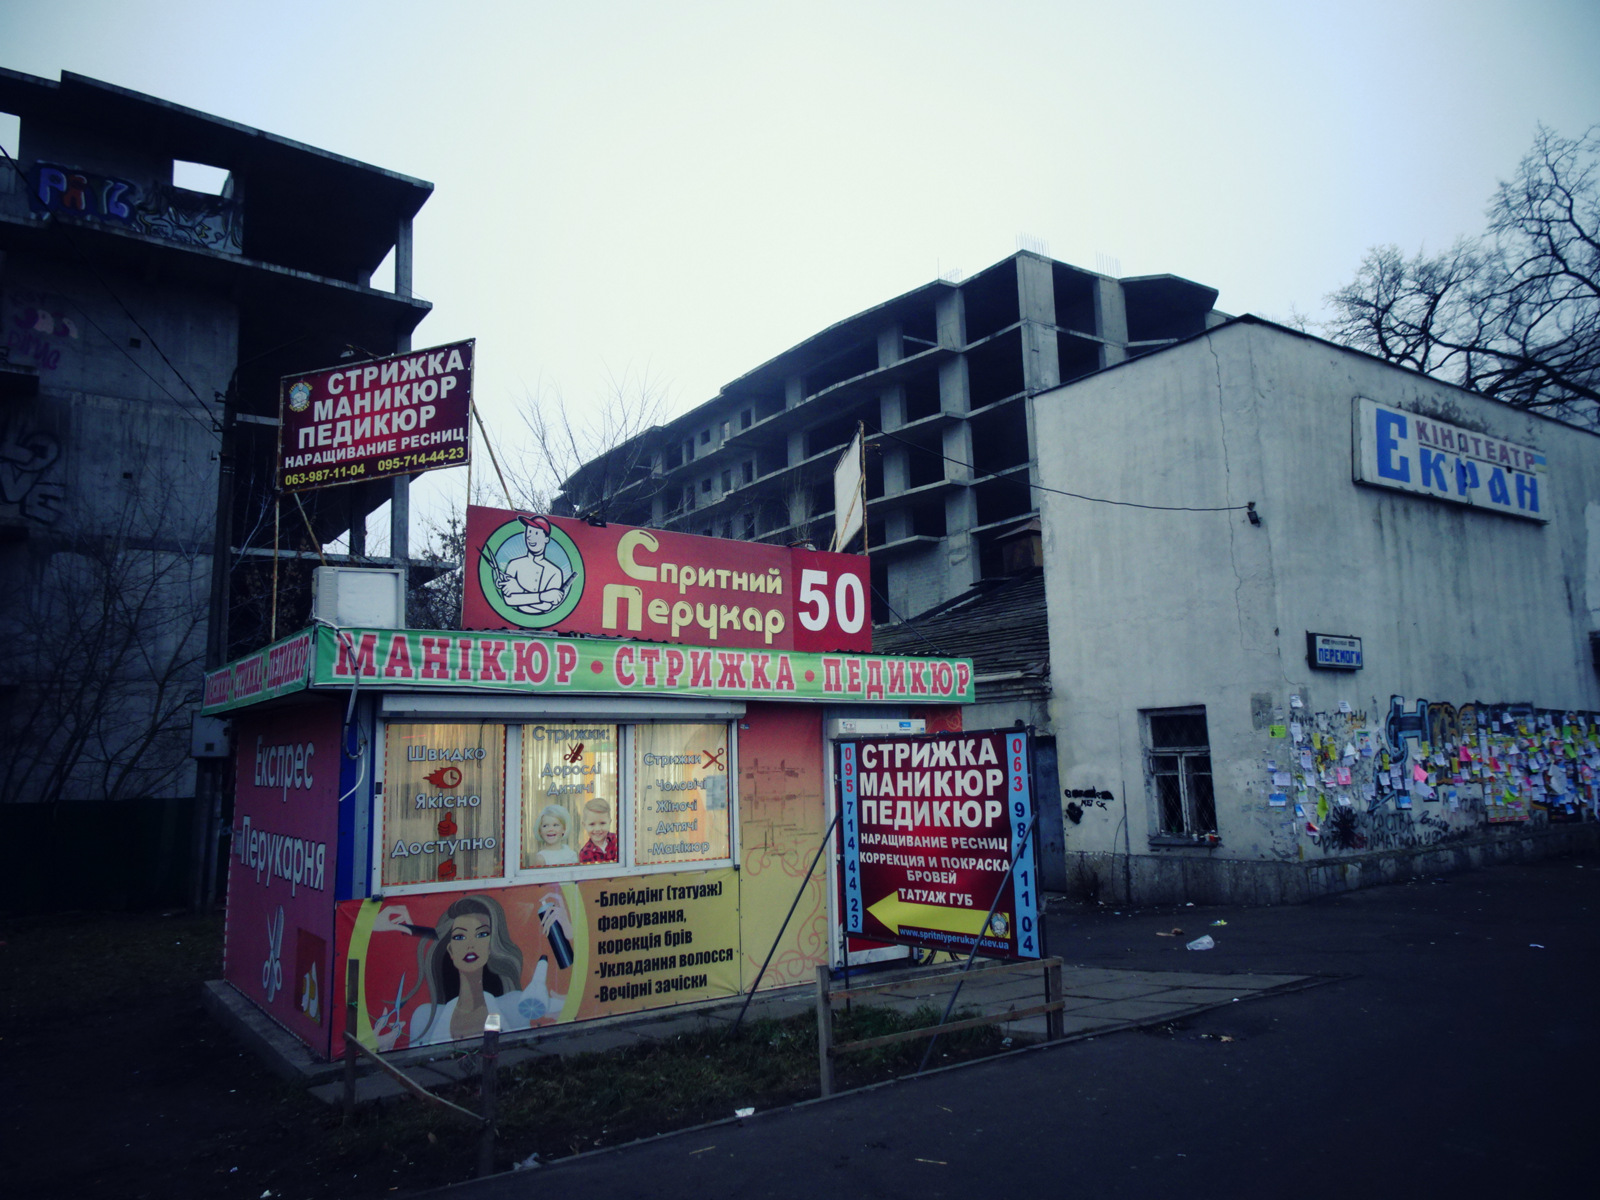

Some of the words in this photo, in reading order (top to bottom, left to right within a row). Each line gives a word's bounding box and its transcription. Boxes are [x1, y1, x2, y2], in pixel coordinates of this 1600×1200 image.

[327, 349, 465, 395] СТРИЖКА
[313, 375, 457, 423] МАНИКЮР
[298, 405, 436, 449] ПЕДИКЮР
[285, 439, 397, 469] НАРАЩИВАНИЕ
[401, 427, 465, 450] РЕСНИЦ
[1415, 420, 1535, 470] КІНОТЕАТР
[284, 463, 365, 486] 063-987-11-04
[377, 447, 465, 471] 095-714-44-23
[617, 529, 783, 595] Спритний
[797, 569, 866, 634] 50
[601, 584, 786, 645] Перукар
[334, 632, 577, 685] МАНІКЮР
[614, 646, 795, 691] СТРИЖКА
[822, 656, 970, 700] ПЕДИКЮР
[254, 734, 315, 803] Експрес
[407, 745, 487, 763] Швидко
[541, 761, 601, 777] Дорослі
[643, 752, 702, 768] Стрижки
[861, 738, 999, 769] СТРИЖКА
[546, 781, 595, 797] Дитячі
[859, 768, 1004, 797] МАНИКЮР
[415, 792, 481, 810] Якісно
[861, 799, 1003, 831] ПЕДИКЮР
[241, 815, 326, 898] Перукарня
[390, 836, 497, 860] Доступно
[860, 832, 948, 850] НАРАЩИВАНИЕ
[951, 836, 1008, 853] РЕСНИЦ
[859, 851, 926, 870] КОРРЕКЦИЯ
[928, 856, 938, 868] И
[941, 856, 1010, 873] ПОКРАСКА
[906, 869, 957, 885] БРОВЕЙ
[595, 885, 663, 909] -Блейдінг
[666, 880, 723, 903] (татуаж)
[898, 887, 947, 904] ТАТУАЖ
[949, 892, 974, 907] ГУБ
[597, 911, 687, 933] фарбування,
[597, 936, 662, 957] корекція
[664, 930, 693, 949] брів
[595, 955, 678, 980] -Укладання
[679, 948, 734, 968] волосся
[595, 981, 652, 1004] -Вечірні
[654, 973, 708, 997] зачіски
